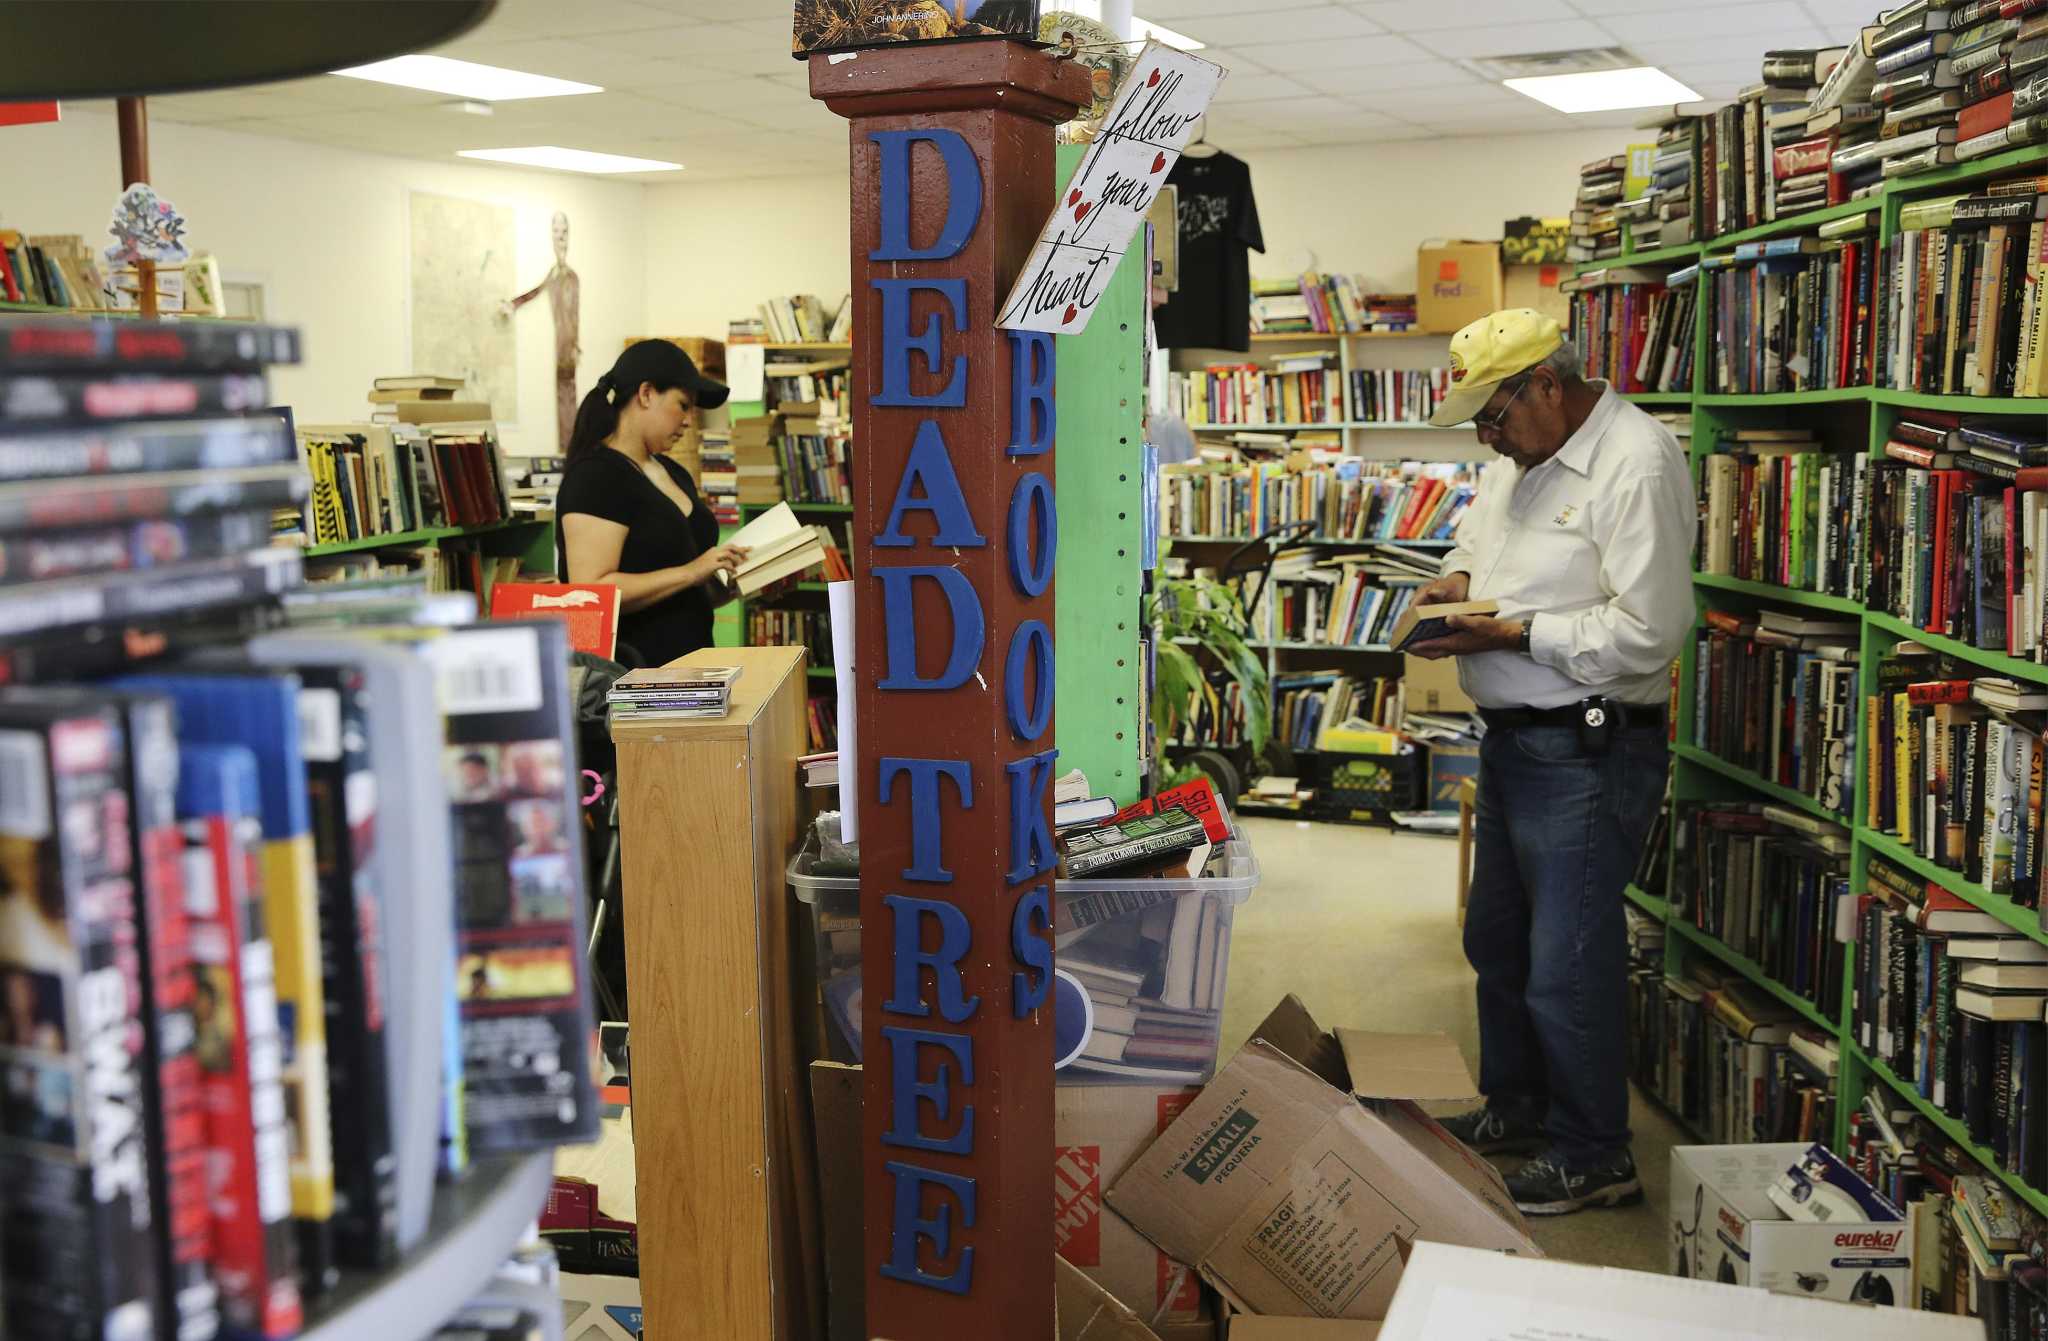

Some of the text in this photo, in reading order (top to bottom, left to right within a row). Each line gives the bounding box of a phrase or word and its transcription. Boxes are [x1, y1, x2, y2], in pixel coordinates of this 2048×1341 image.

[871, 14, 895, 25] JOHN
[1080, 70, 1200, 187] follow
[1070, 171, 1152, 245] your
[998, 230, 1109, 326] heart
[1936, 233, 1948, 254] ED
[2030, 270, 2045, 359] Terry McMillan
[1005, 329, 1060, 1019] BOOKS
[867, 127, 987, 1296] DEAD TREE
[1963, 721, 1977, 821] JAMES PATTERSON
[1984, 725, 2000, 800] JAMES PATTERSON
[2030, 752, 2042, 790] SAIL
[1087, 850, 1113, 868] PATRICIA
[1114, 843, 1144, 862] CORNWELL
[2025, 808, 2036, 878] JAMES PATTERSON
[1936, 959, 1948, 1023] ANNE PERRY
[1195, 1118, 1246, 1173] SMALL
[1257, 1201, 1297, 1244] FRAGI
[1834, 1229, 1903, 1248] eureka!
